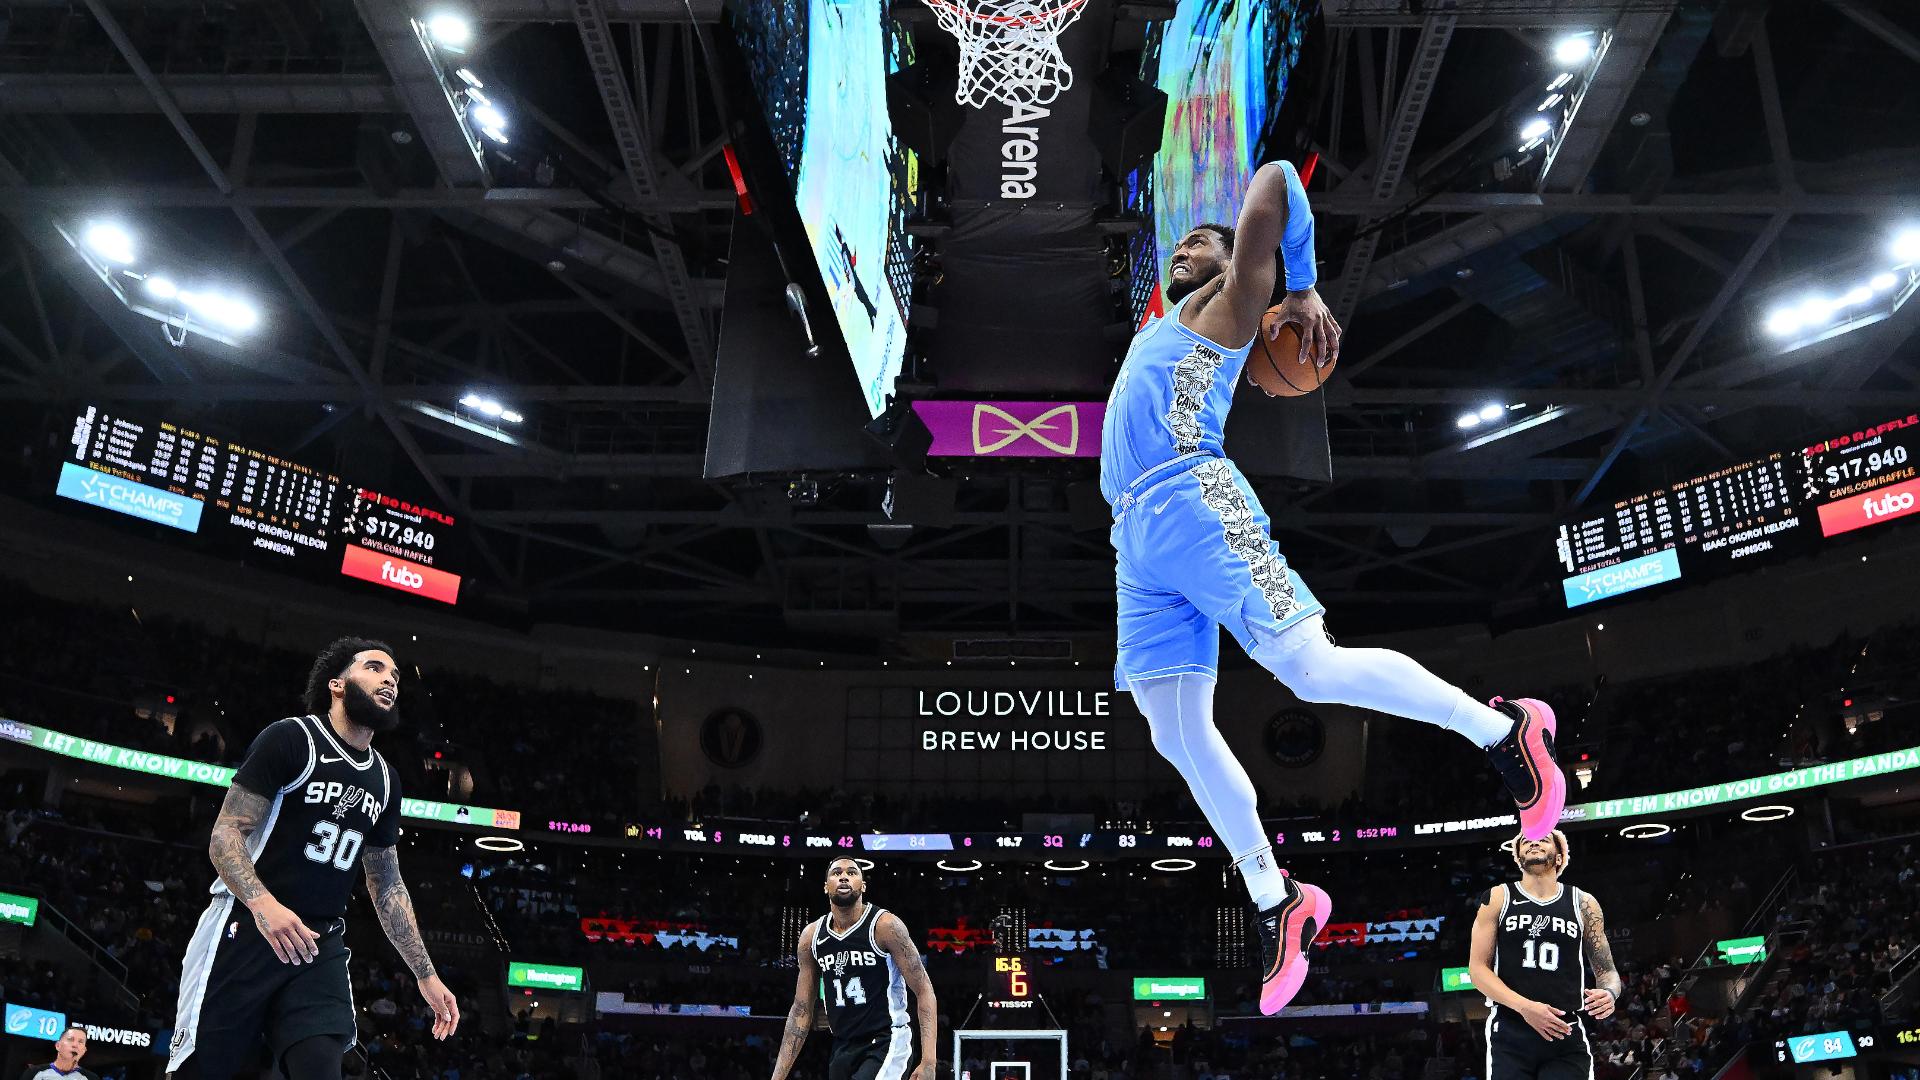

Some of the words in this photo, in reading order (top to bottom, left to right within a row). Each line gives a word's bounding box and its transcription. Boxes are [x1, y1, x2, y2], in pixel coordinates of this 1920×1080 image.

[1001, 99, 1050, 198] Arena
[1852, 414, 1919, 442] RAFFLE
[1826, 446, 1907, 485] $17,940
[110, 484, 183, 516] CHAMPS
[1862, 492, 1914, 518] fubo
[401, 501, 454, 526] RAFFLE
[230, 514, 257, 530] ISAAC
[293, 532, 328, 550] KELDON
[366, 516, 434, 550] $17,940
[1702, 538, 1728, 552] ISAAC
[1763, 517, 1799, 535] KELDON
[382, 560, 423, 588] fubo
[1602, 560, 1663, 587] CHAMPS
[918, 690, 1110, 717] LOUDVILLE
[922, 730, 1001, 752] BREW
[1011, 730, 1106, 752] HOUSE
[43, 730, 76, 752] LET
[117, 748, 184, 775] KNOW
[187, 762, 226, 783] YOU
[1595, 800, 1622, 818] LET
[1664, 785, 1721, 806] KNOW
[1725, 779, 1762, 799] YOU
[1768, 770, 1808, 790] GOT
[1813, 763, 1846, 781] THE
[1852, 750, 1919, 775] PANDA
[304, 782, 383, 824] SPURS
[647, 826, 662, 839] +1
[684, 830, 706, 842] TOL
[714, 831, 722, 842] 5
[739, 834, 775, 845] FOULS
[783, 835, 791, 847] 5
[838, 836, 853, 847] 42
[1119, 835, 1136, 848] 83
[1276, 833, 1284, 844] 5
[1302, 831, 1325, 842] TOL
[1332, 830, 1340, 842] 2
[1356, 829, 1378, 839] 8:52
[1380, 827, 1397, 837] PM
[1414, 823, 1443, 835] LET
[303, 820, 364, 871] 30
[910, 838, 926, 847] 84
[964, 838, 972, 847] 6
[996, 837, 1022, 847] 16.7
[1044, 836, 1063, 848] 3Q
[1198, 836, 1213, 848] 40
[1505, 915, 1578, 939] SPURS
[817, 950, 877, 976] SPURS
[1522, 940, 1559, 972] 10
[832, 976, 867, 1007] 14
[1012, 972, 1027, 996] 6
[39, 1017, 58, 1036] 10
[1778, 1050, 1785, 1062] 5
[1824, 1038, 1842, 1054] 84
